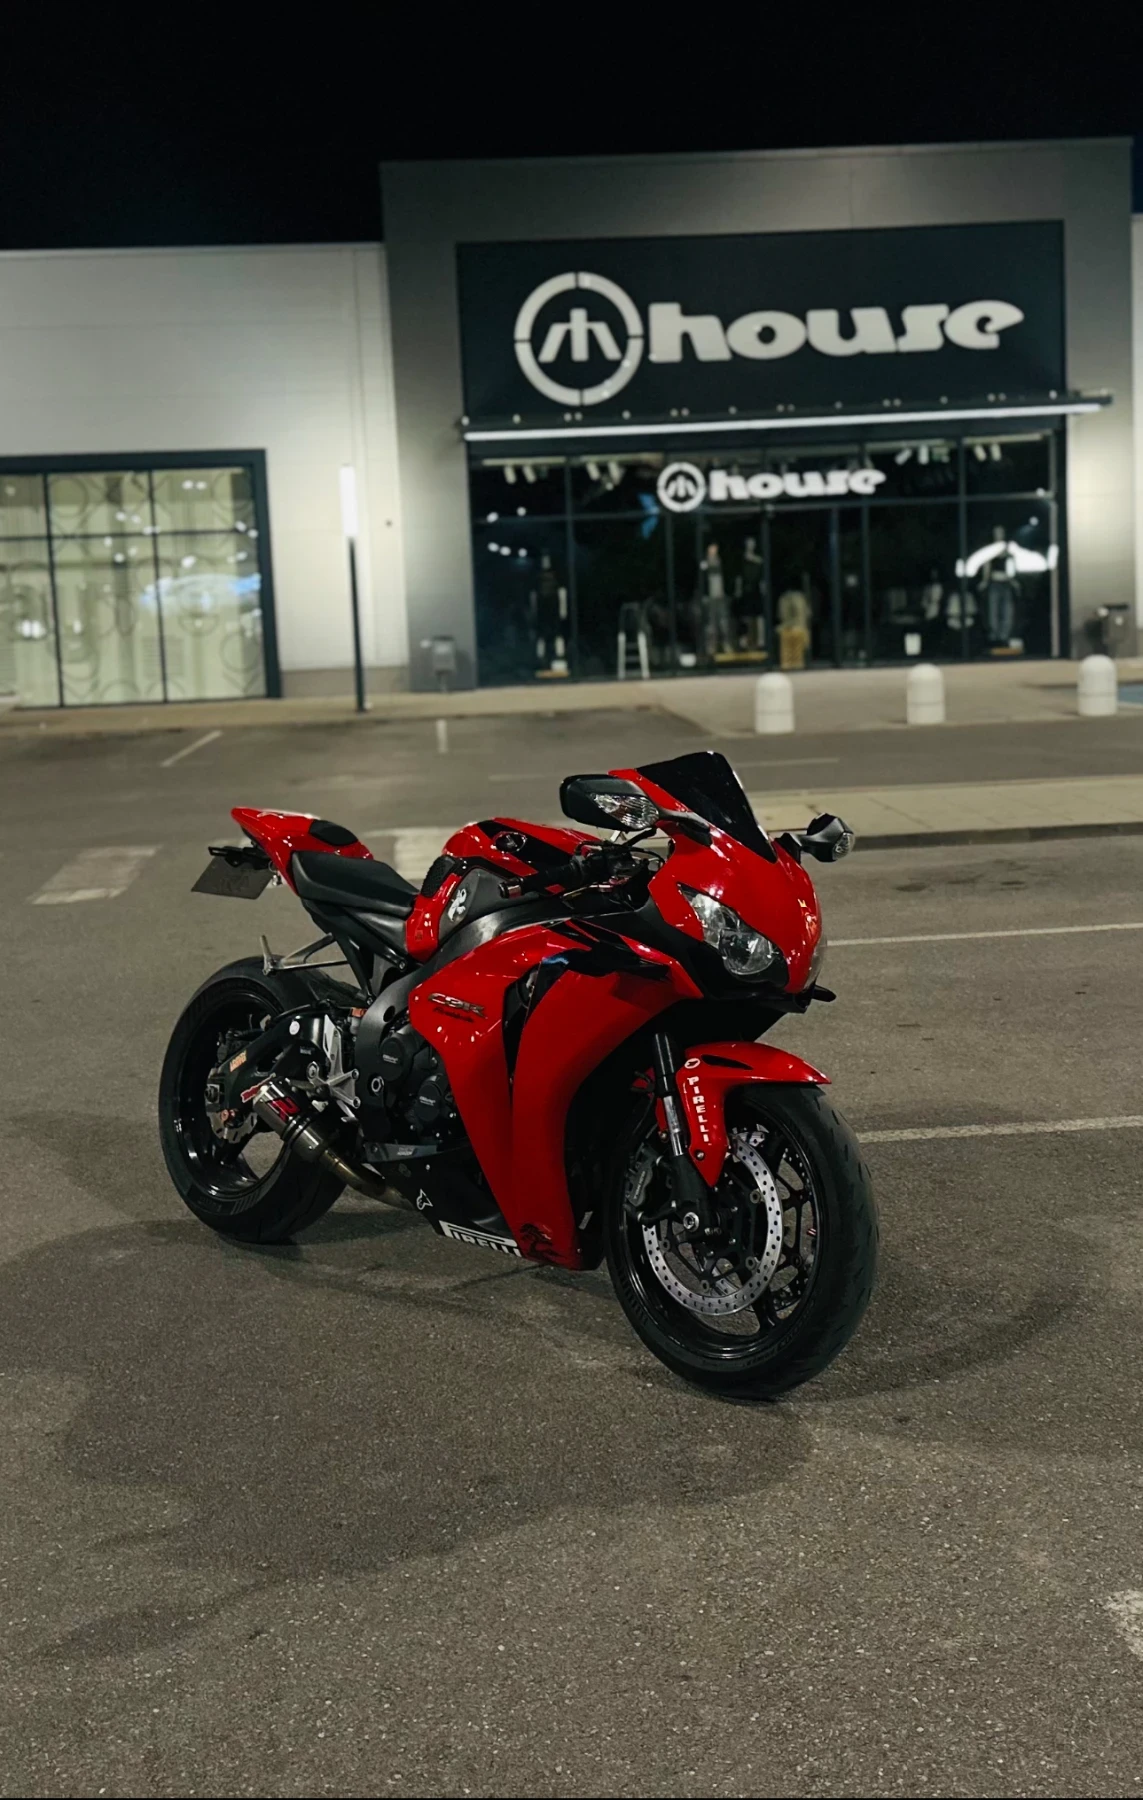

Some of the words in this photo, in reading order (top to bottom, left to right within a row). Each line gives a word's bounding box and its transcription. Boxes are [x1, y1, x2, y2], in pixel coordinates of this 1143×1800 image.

[648, 300, 1024, 363] house
[708, 468, 887, 500] house
[686, 1075, 710, 1143] PIRELLI
